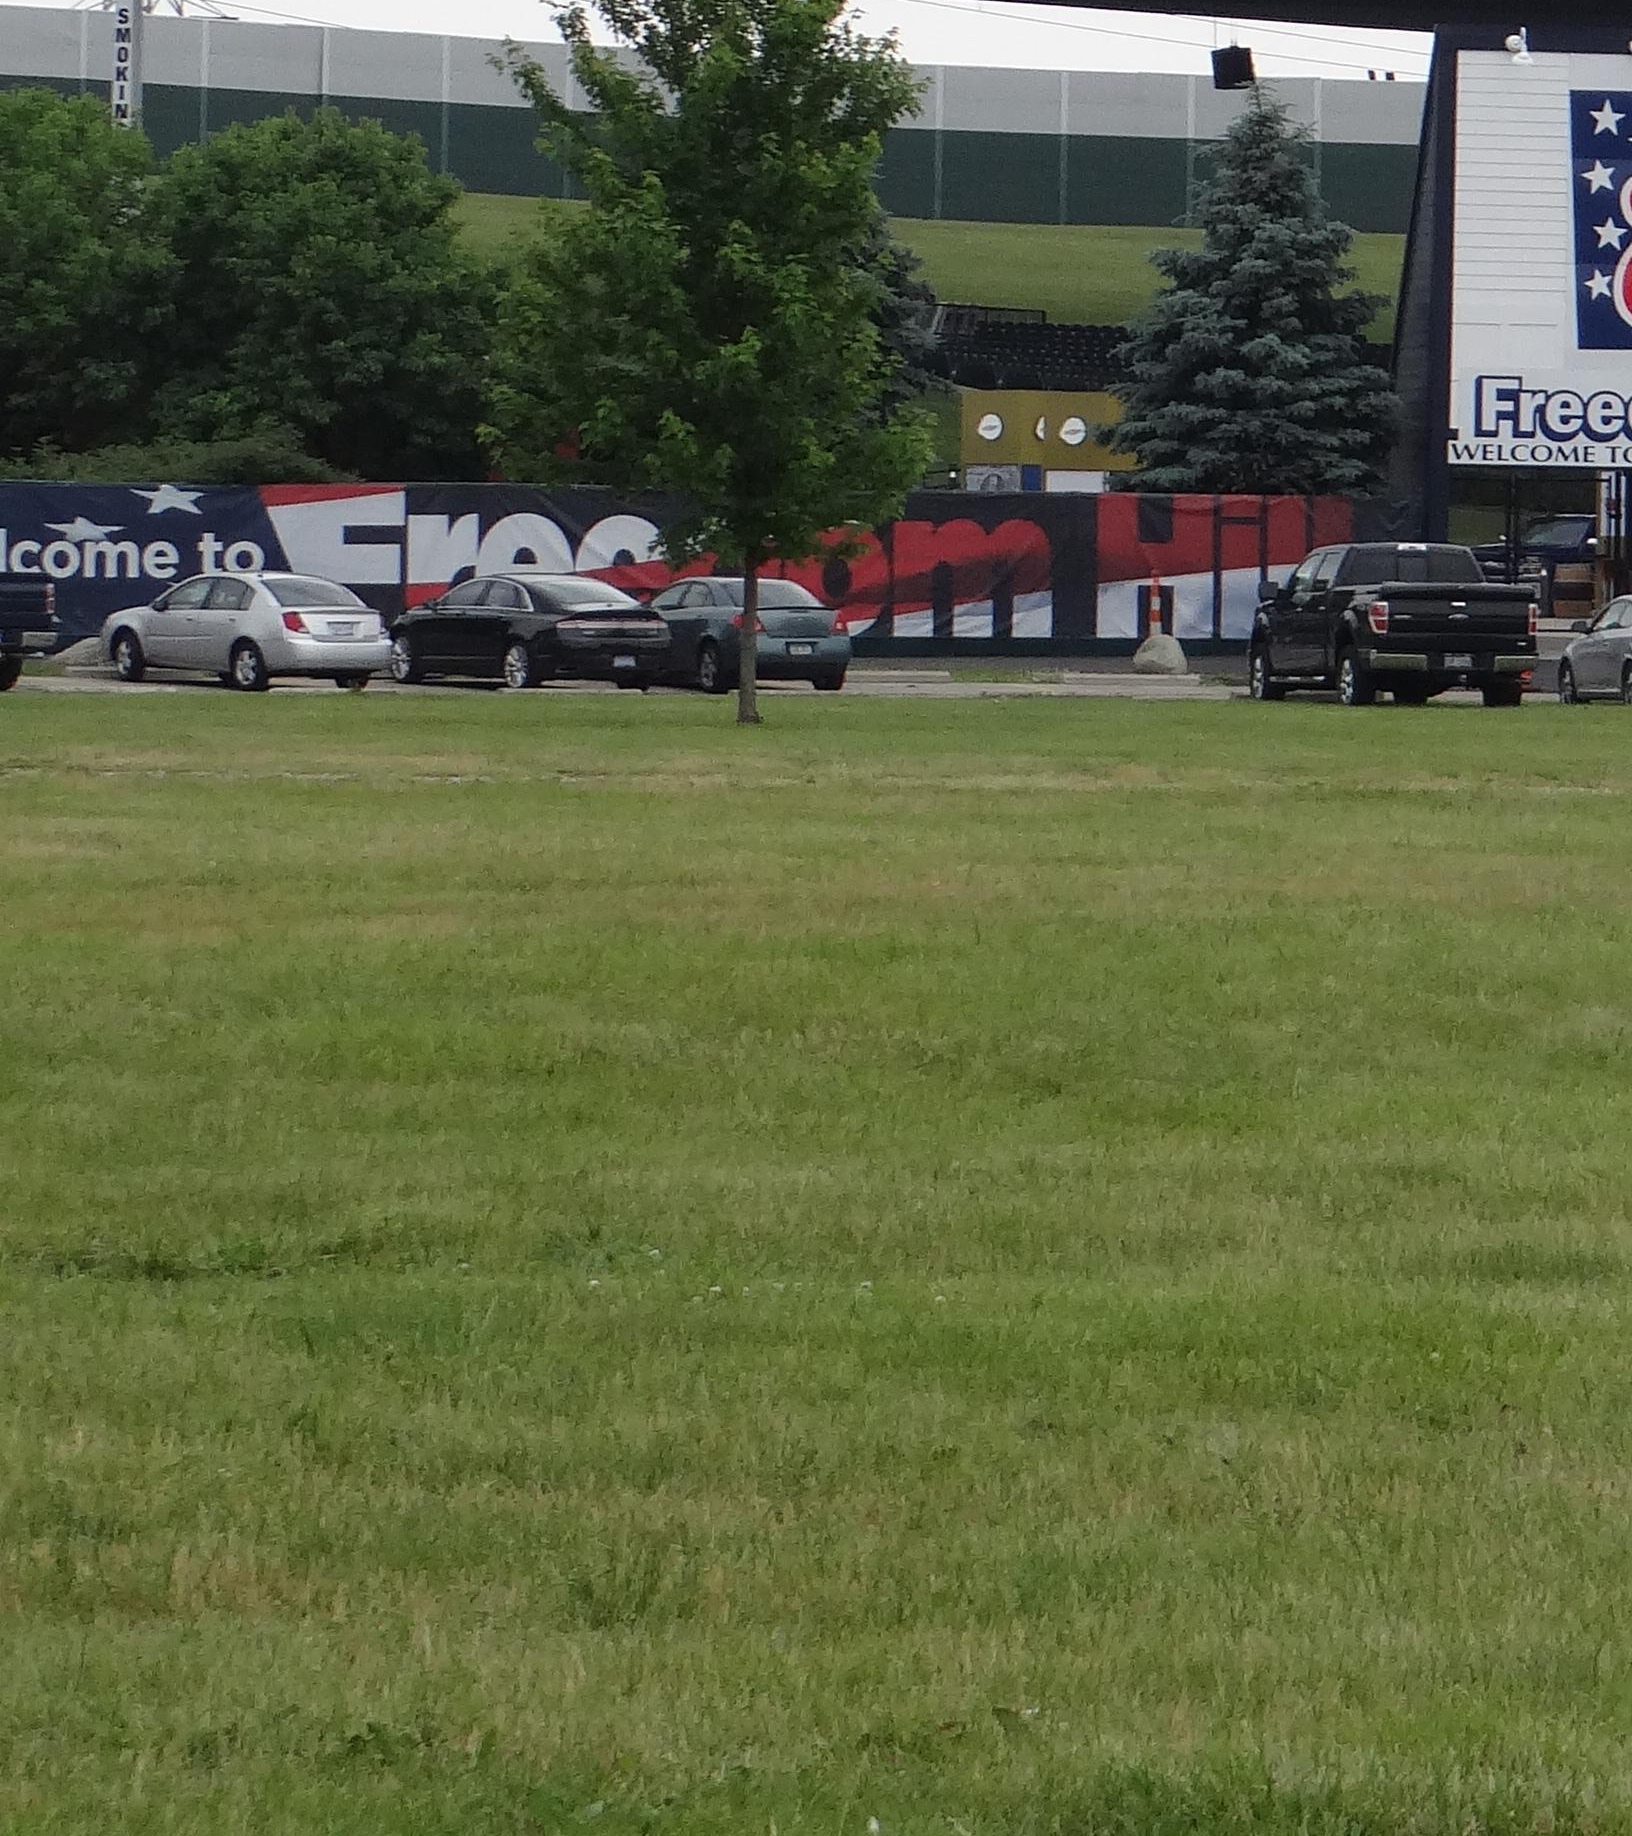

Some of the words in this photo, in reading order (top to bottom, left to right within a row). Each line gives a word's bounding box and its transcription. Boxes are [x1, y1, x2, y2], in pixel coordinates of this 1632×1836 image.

[115, 8, 132, 126] SMOKIN
[1450, 443, 1595, 464] WELCOME
[197, 531, 266, 573] to
